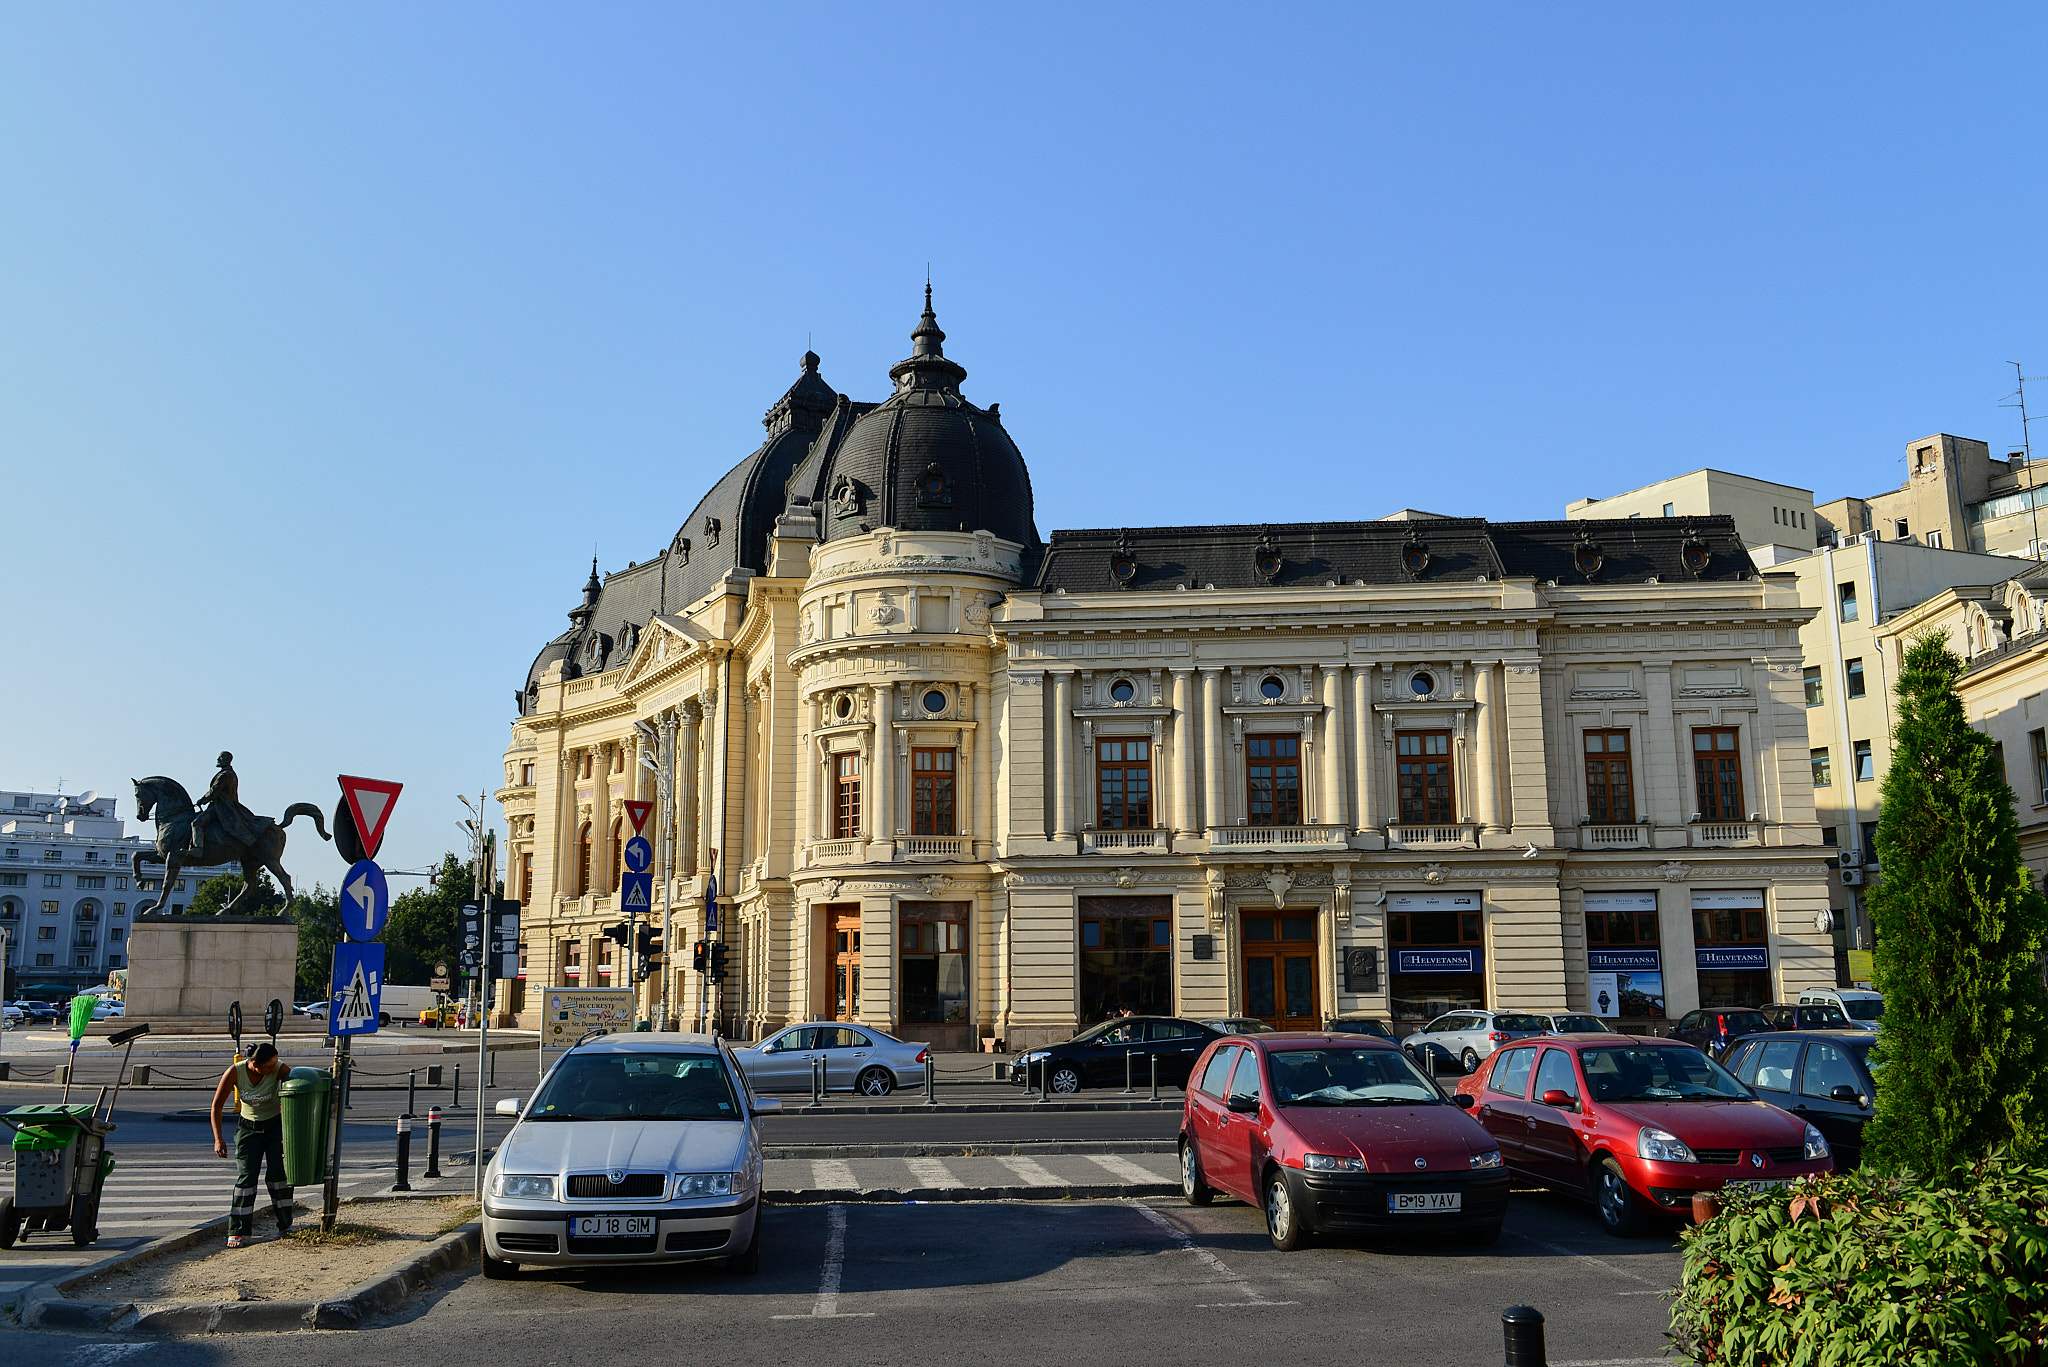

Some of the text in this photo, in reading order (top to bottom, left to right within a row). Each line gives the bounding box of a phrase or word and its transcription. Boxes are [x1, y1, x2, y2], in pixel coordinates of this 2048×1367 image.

[1411, 955, 1468, 964] HELVETANSA
[1598, 955, 1655, 964] HELVETANSA
[1706, 953, 1763, 962] HELVETANSA
[1400, 1194, 1455, 1208] B 19 YAV
[582, 1217, 650, 1234] CJ 18 GIM
